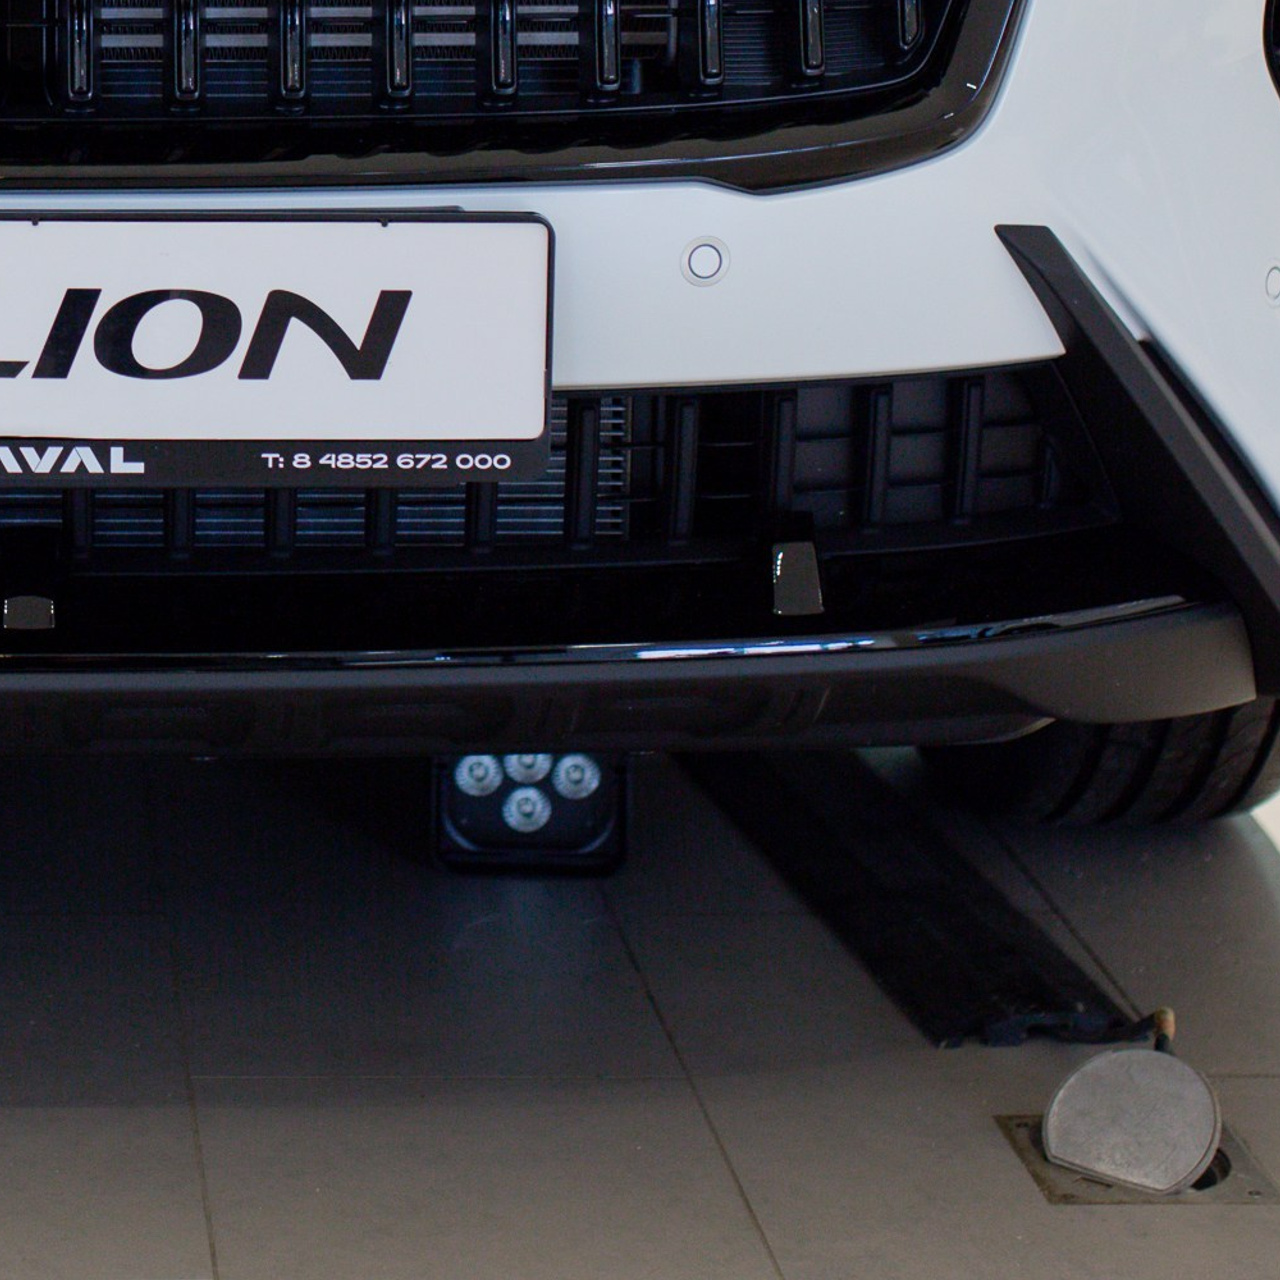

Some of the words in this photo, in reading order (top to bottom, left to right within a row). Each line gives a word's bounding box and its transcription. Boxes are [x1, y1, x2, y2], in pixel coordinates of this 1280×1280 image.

[292, 453, 312, 469] 8
[318, 453, 389, 469] 4852
[396, 453, 449, 469] 672
[455, 453, 512, 470] 000
